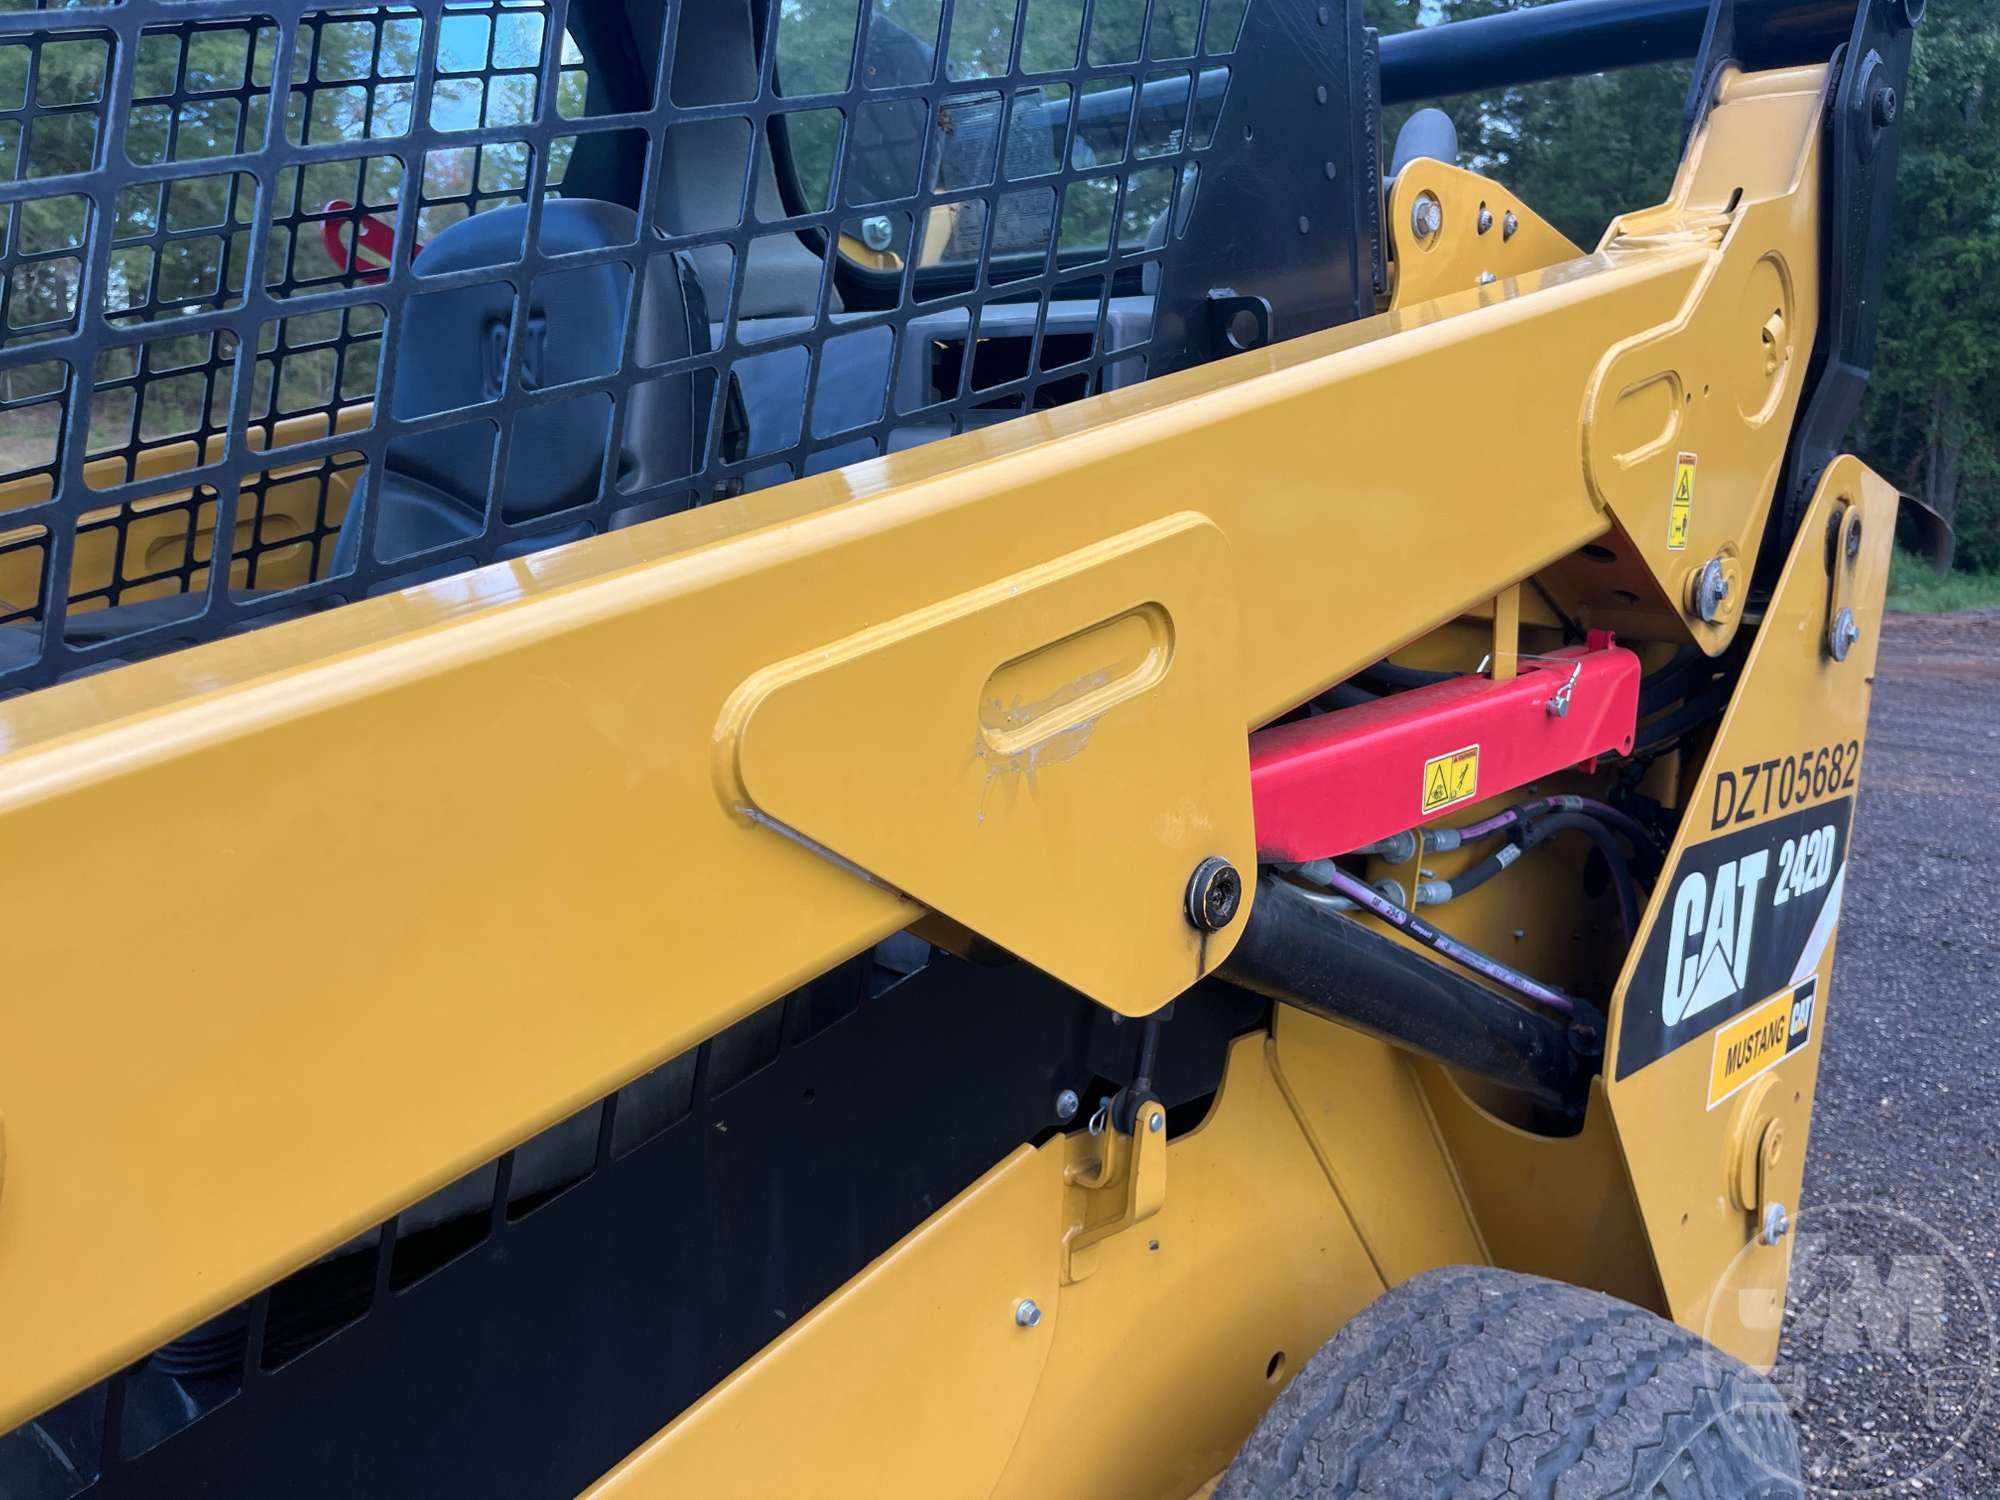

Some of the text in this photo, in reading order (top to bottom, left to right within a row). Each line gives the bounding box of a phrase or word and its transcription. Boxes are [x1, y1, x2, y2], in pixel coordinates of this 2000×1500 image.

[1711, 740, 1859, 831] DZT05682
[1662, 849, 1769, 1027] CAT
[1773, 824, 1836, 907] 242D
[1725, 1015, 1785, 1077] MUSTANG
[1789, 994, 1814, 1037] CAT
